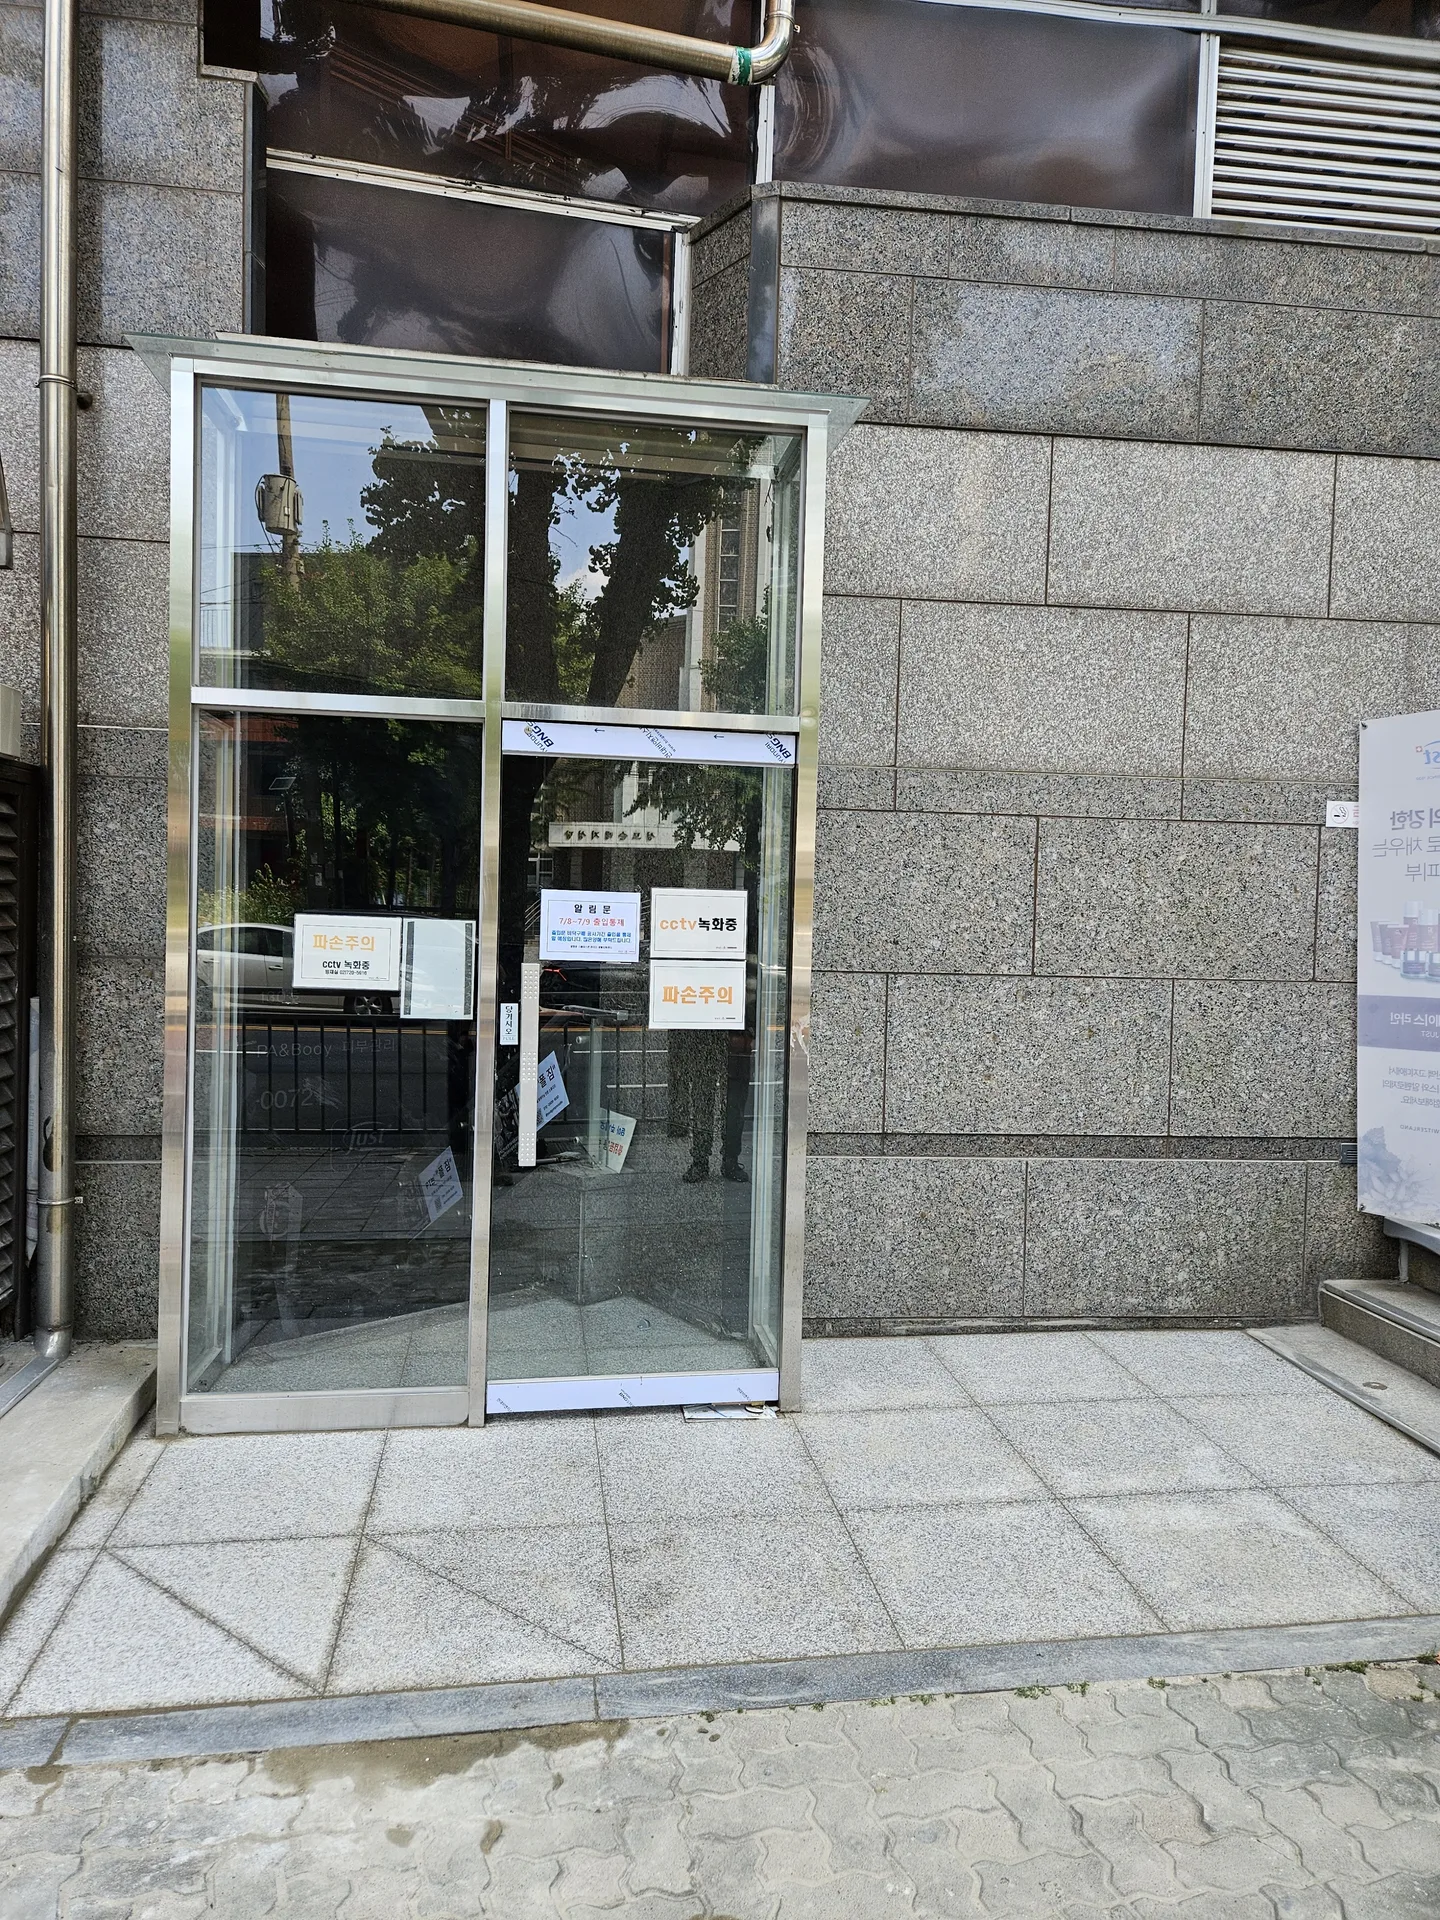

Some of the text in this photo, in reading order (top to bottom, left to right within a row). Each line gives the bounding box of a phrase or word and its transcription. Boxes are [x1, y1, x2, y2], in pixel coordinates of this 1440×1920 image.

[559, 917, 625, 927] 7/8~7/9 출입통제
[312, 934, 375, 951] 파손주의
[344, 960, 370, 970] 녹화중
[662, 985, 733, 1004] 파손주의
[505, 1005, 513, 1035] 당기시오
